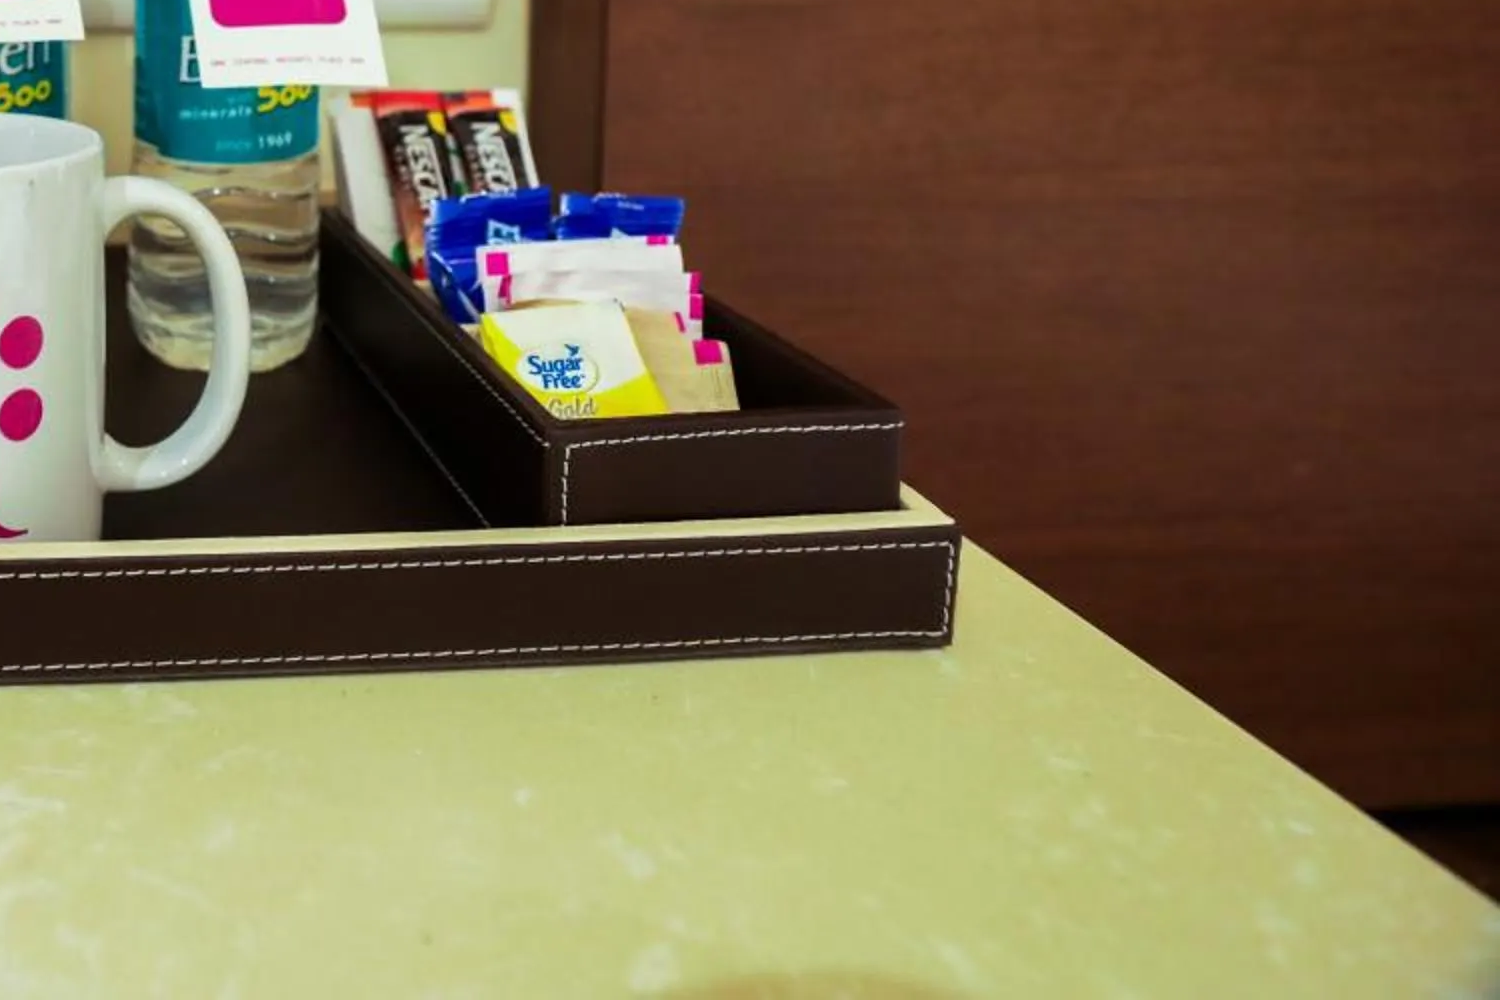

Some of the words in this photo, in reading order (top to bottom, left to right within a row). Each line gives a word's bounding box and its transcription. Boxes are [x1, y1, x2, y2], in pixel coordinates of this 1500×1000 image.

[257, 131, 293, 150] 1969
[399, 124, 448, 212] NESCA
[526, 354, 584, 378] Sugar
[541, 372, 583, 390] Free
[548, 397, 597, 417] Gold
